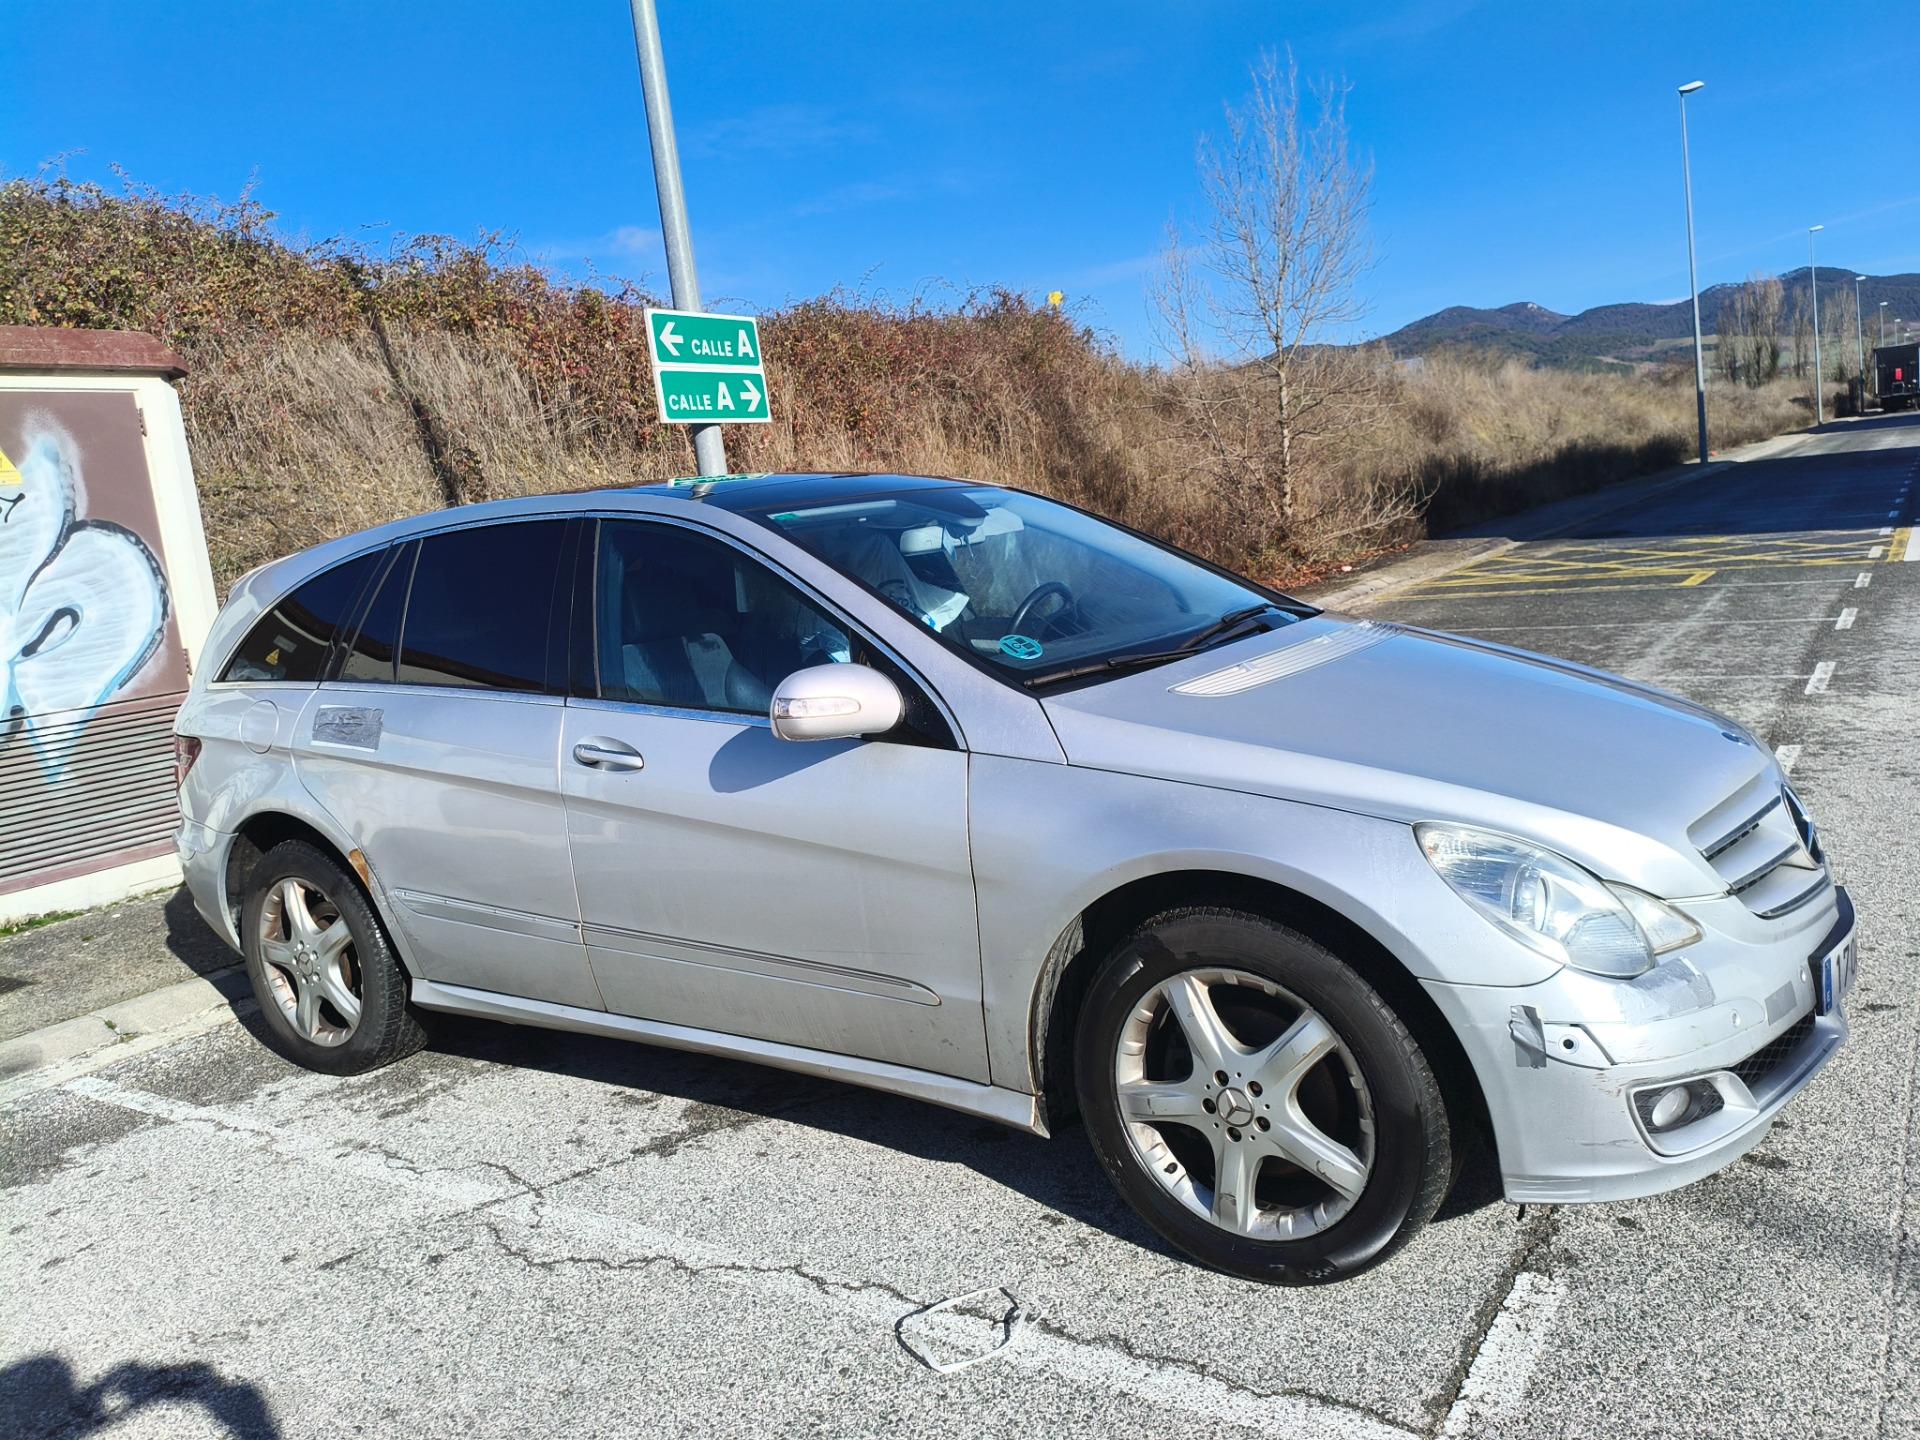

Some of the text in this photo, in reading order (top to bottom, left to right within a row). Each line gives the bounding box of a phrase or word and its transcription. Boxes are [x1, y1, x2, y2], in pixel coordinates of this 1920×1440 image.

[691, 329, 755, 358] CALLE A
[668, 381, 735, 411] CALLE A
